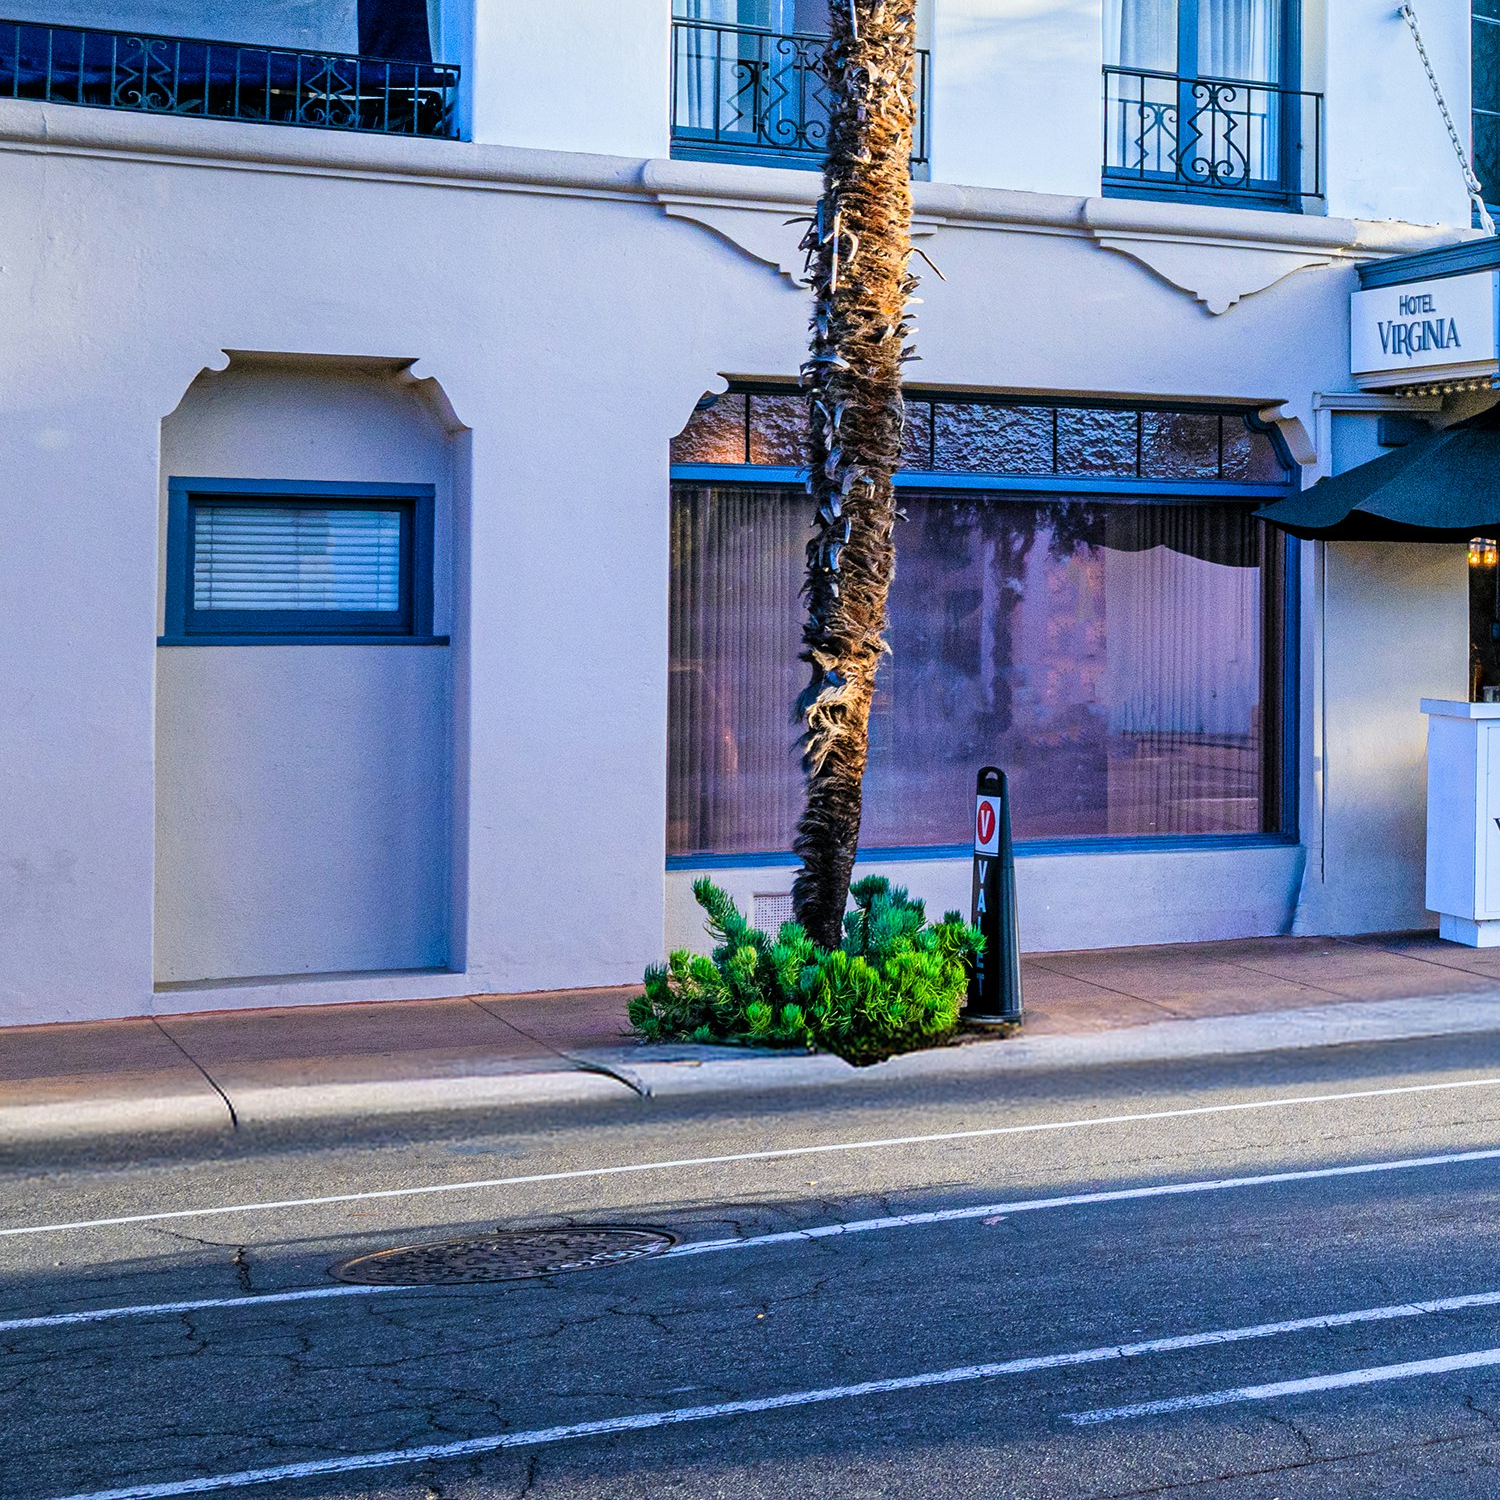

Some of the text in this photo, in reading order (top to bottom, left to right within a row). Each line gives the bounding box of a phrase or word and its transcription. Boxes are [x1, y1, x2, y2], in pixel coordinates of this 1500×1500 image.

[1399, 294, 1437, 316] HOTEL
[1377, 317, 1461, 359] VIRGINIA
[981, 809, 991, 838] V
